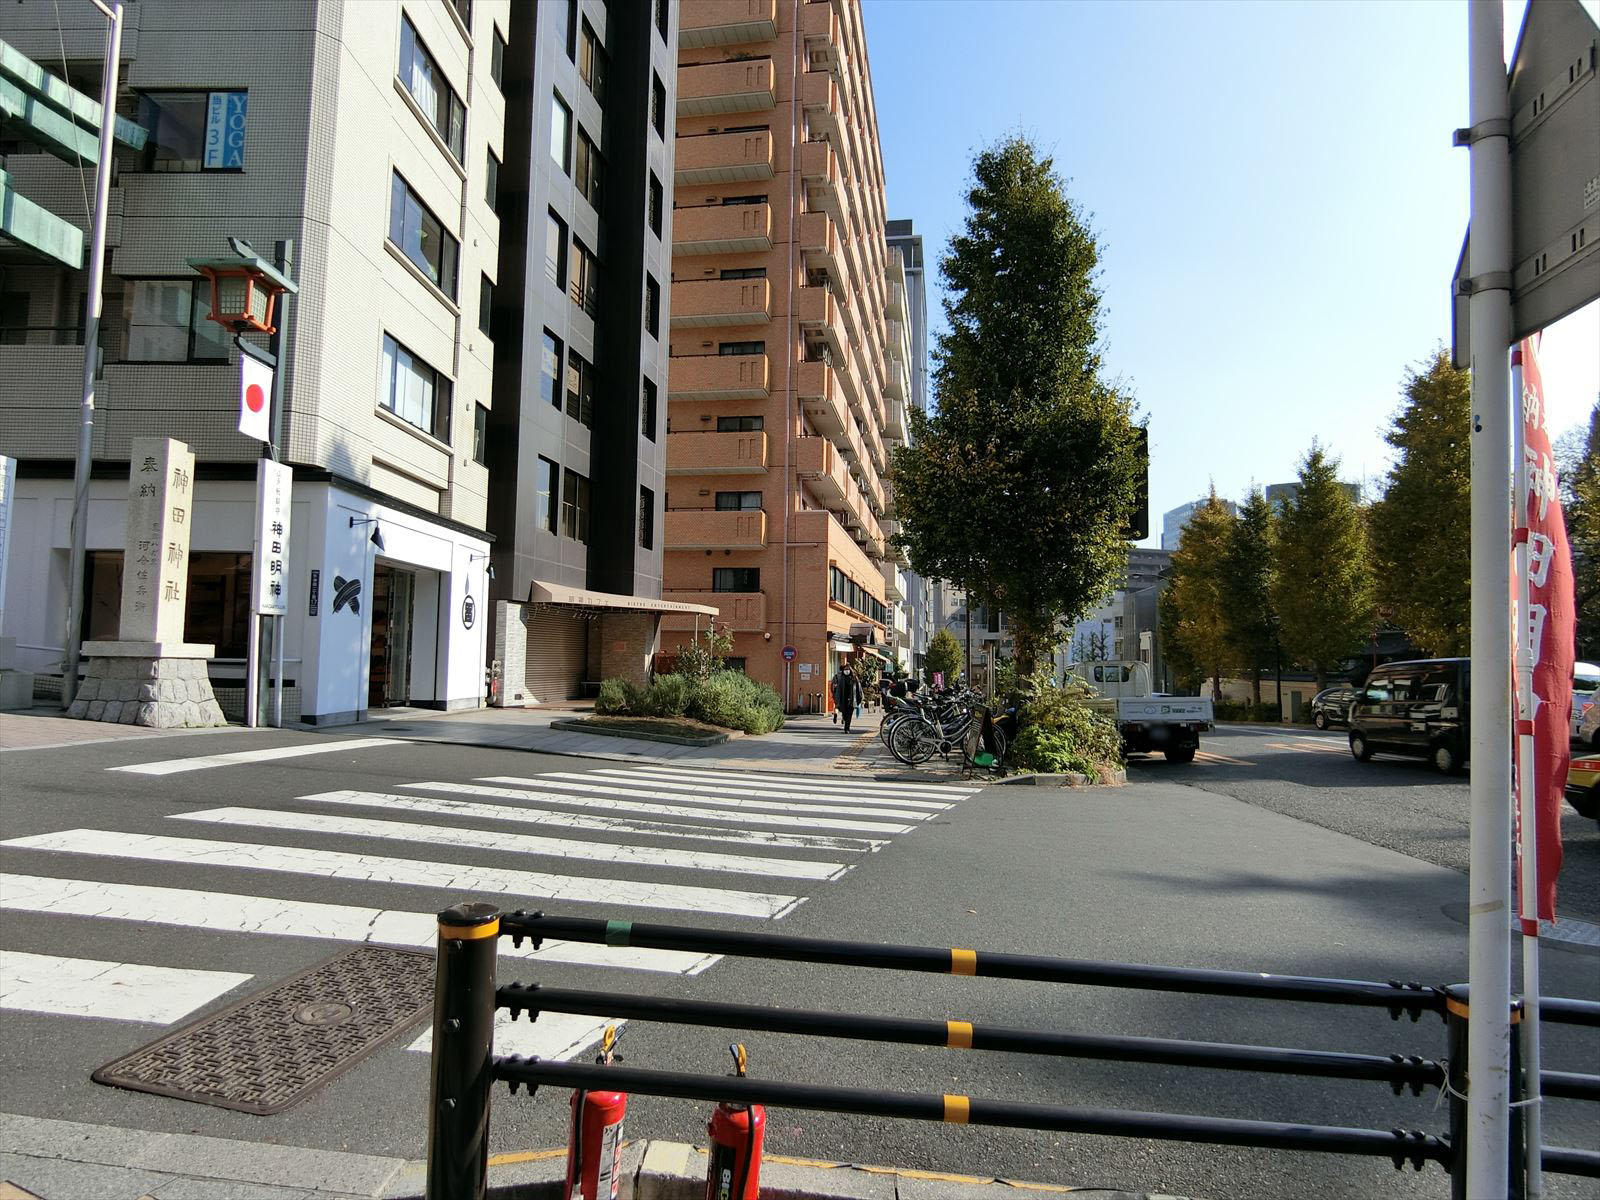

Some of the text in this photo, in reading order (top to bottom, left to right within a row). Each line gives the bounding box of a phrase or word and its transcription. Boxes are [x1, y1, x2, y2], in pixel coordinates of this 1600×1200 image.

[227, 95, 246, 167] YOGA
[140, 456, 158, 497] 奉納
[165, 467, 189, 602] 神田神社
[270, 521, 283, 599] 神田明神
[651, 602, 690, 610] ENTERTAINMENT
